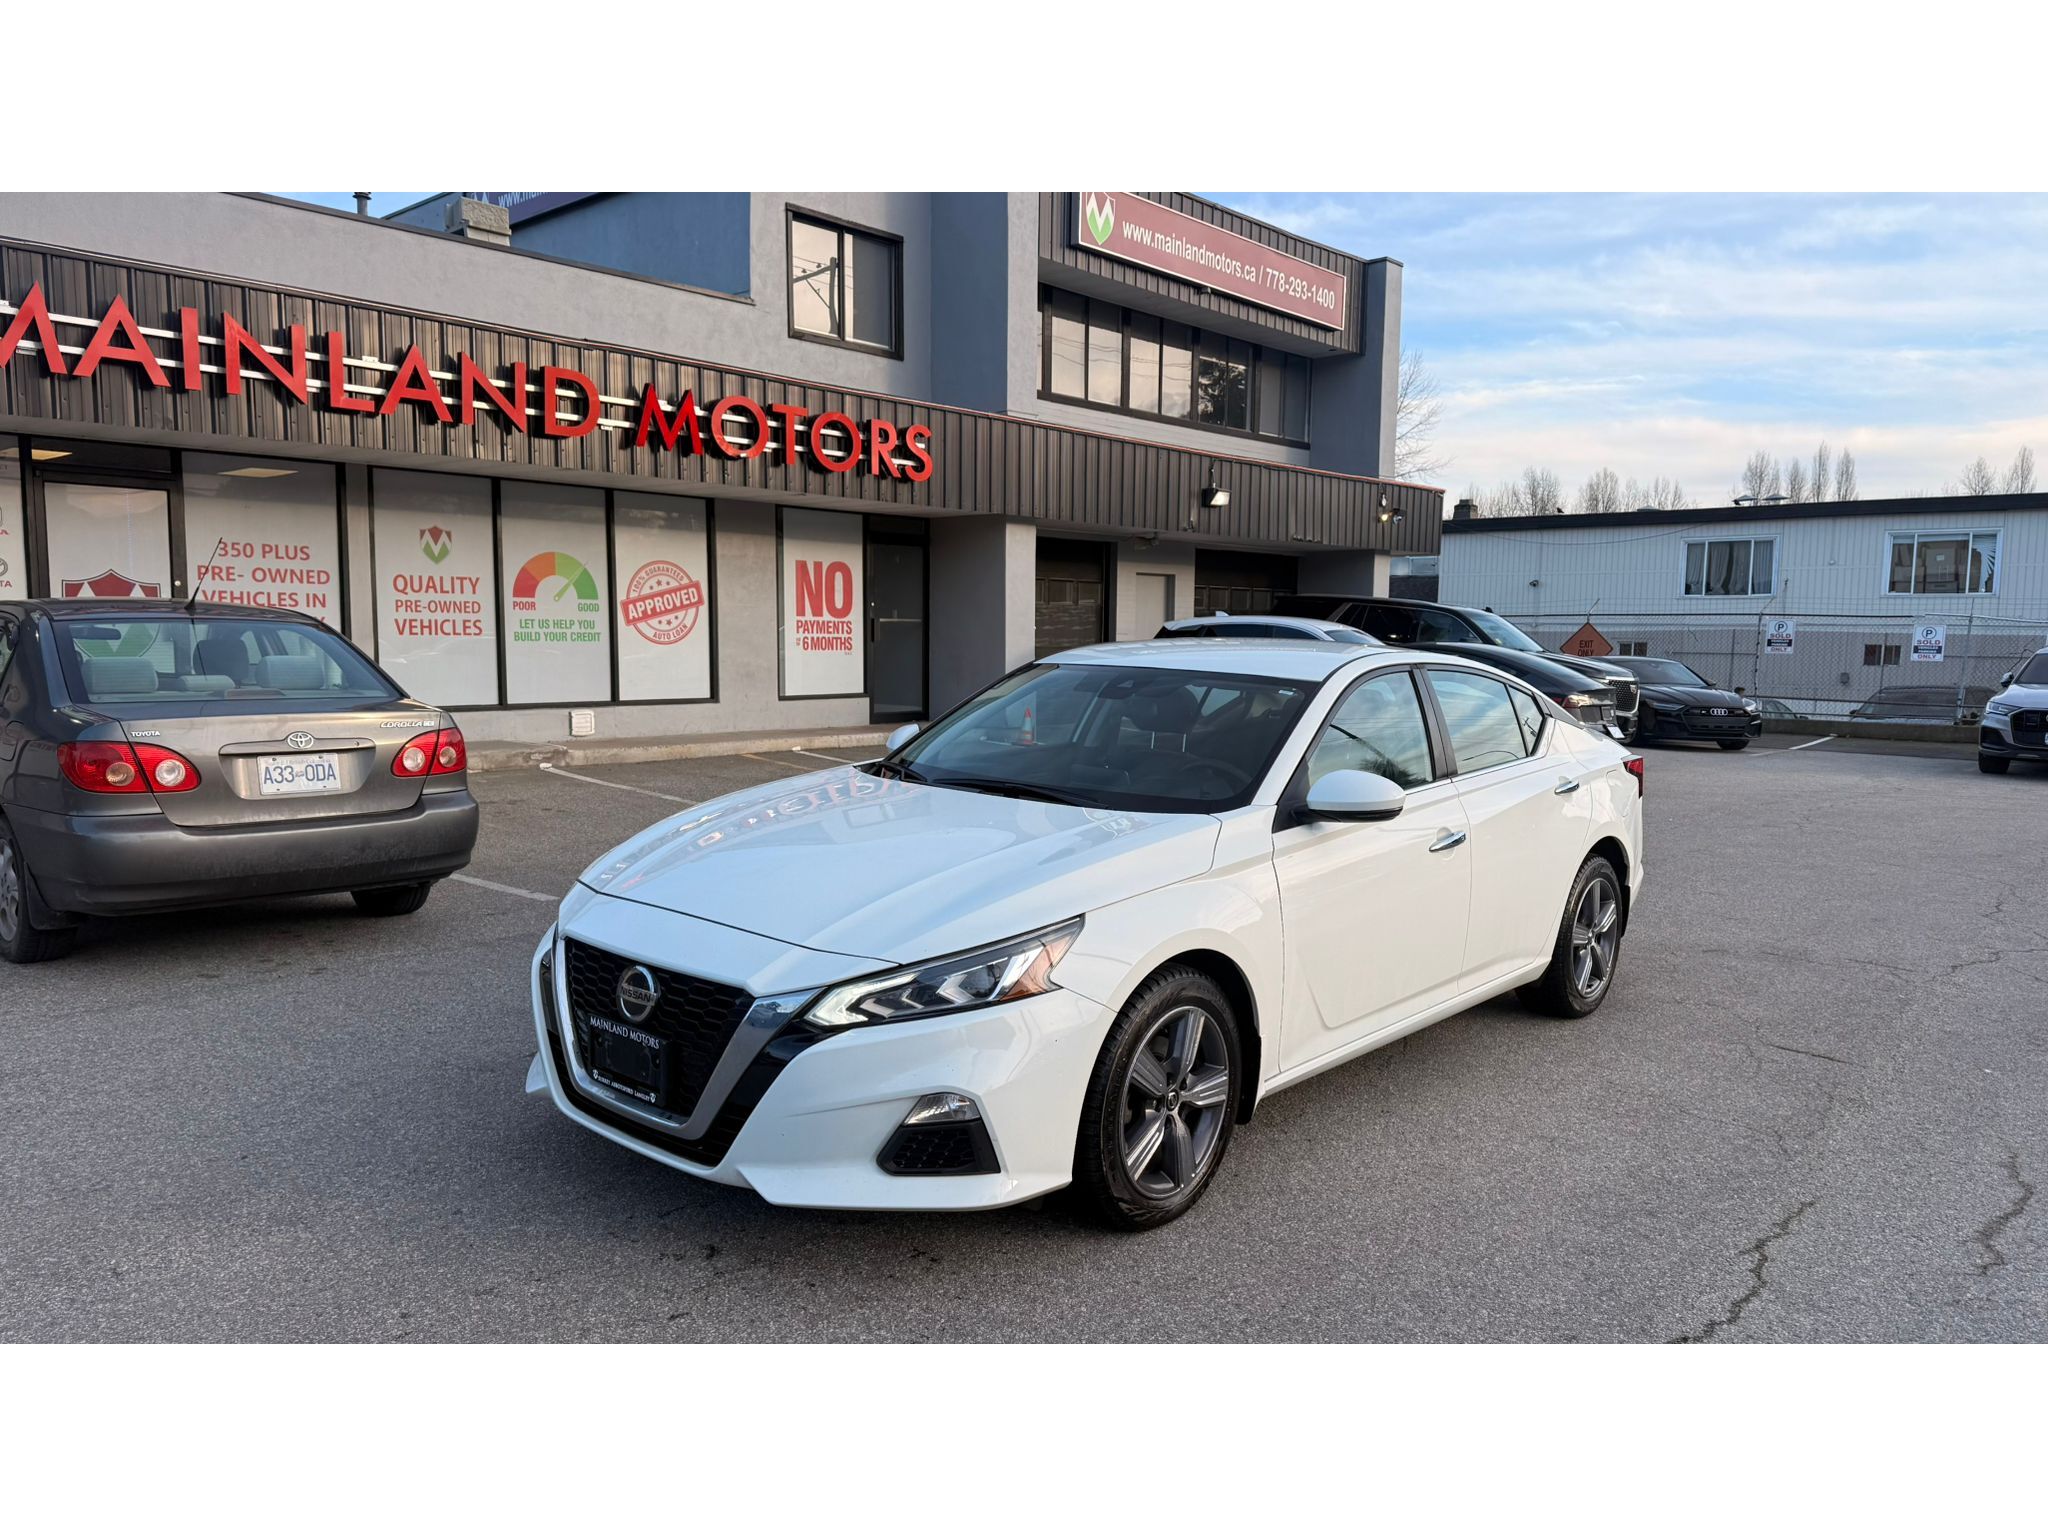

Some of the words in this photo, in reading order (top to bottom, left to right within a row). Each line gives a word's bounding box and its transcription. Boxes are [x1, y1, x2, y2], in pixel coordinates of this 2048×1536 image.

[1122, 220, 1256, 281] www.mainlandmotors.ca
[1265, 268, 1336, 310] 778-293-1400
[635, 383, 933, 482] MOTORS
[218, 541, 255, 559] 350
[261, 543, 311, 561] PLUS
[197, 564, 244, 582] PRE-
[251, 566, 331, 585] OWNED
[632, 575, 645, 593] 100%
[644, 565, 685, 582] GUARANTEED
[392, 574, 480, 595] QUALITY
[795, 559, 853, 619] NO
[201, 589, 299, 608] VEHICLES
[306, 592, 327, 608] IN
[395, 599, 481, 614] PRE-OWNED
[512, 601, 536, 611] POOR
[577, 602, 600, 612] GOOD
[628, 587, 699, 620] APPROVED
[394, 618, 483, 636] VEHICLES
[519, 618, 535, 629] LET
[538, 618, 550, 629] US
[553, 619, 575, 629] HELP
[577, 619, 595, 629] YOU
[652, 631, 671, 640] AUTO
[672, 623, 688, 639] LOAN
[796, 619, 852, 635] PAYMENTS
[514, 631, 541, 641] BUILD
[543, 631, 568, 641] YOUR
[570, 631, 601, 642] CREDIT
[802, 635, 809, 651] 6
[811, 636, 853, 651] MONTHS
[1579, 640, 1593, 648] EXIT
[1577, 649, 1594, 657] ONLY
[380, 720, 422, 728] COROLLA
[622, 987, 653, 1002] NISSAN
[590, 1016, 629, 1037] MAINLAND
[630, 1030, 660, 1049] MOTORS
